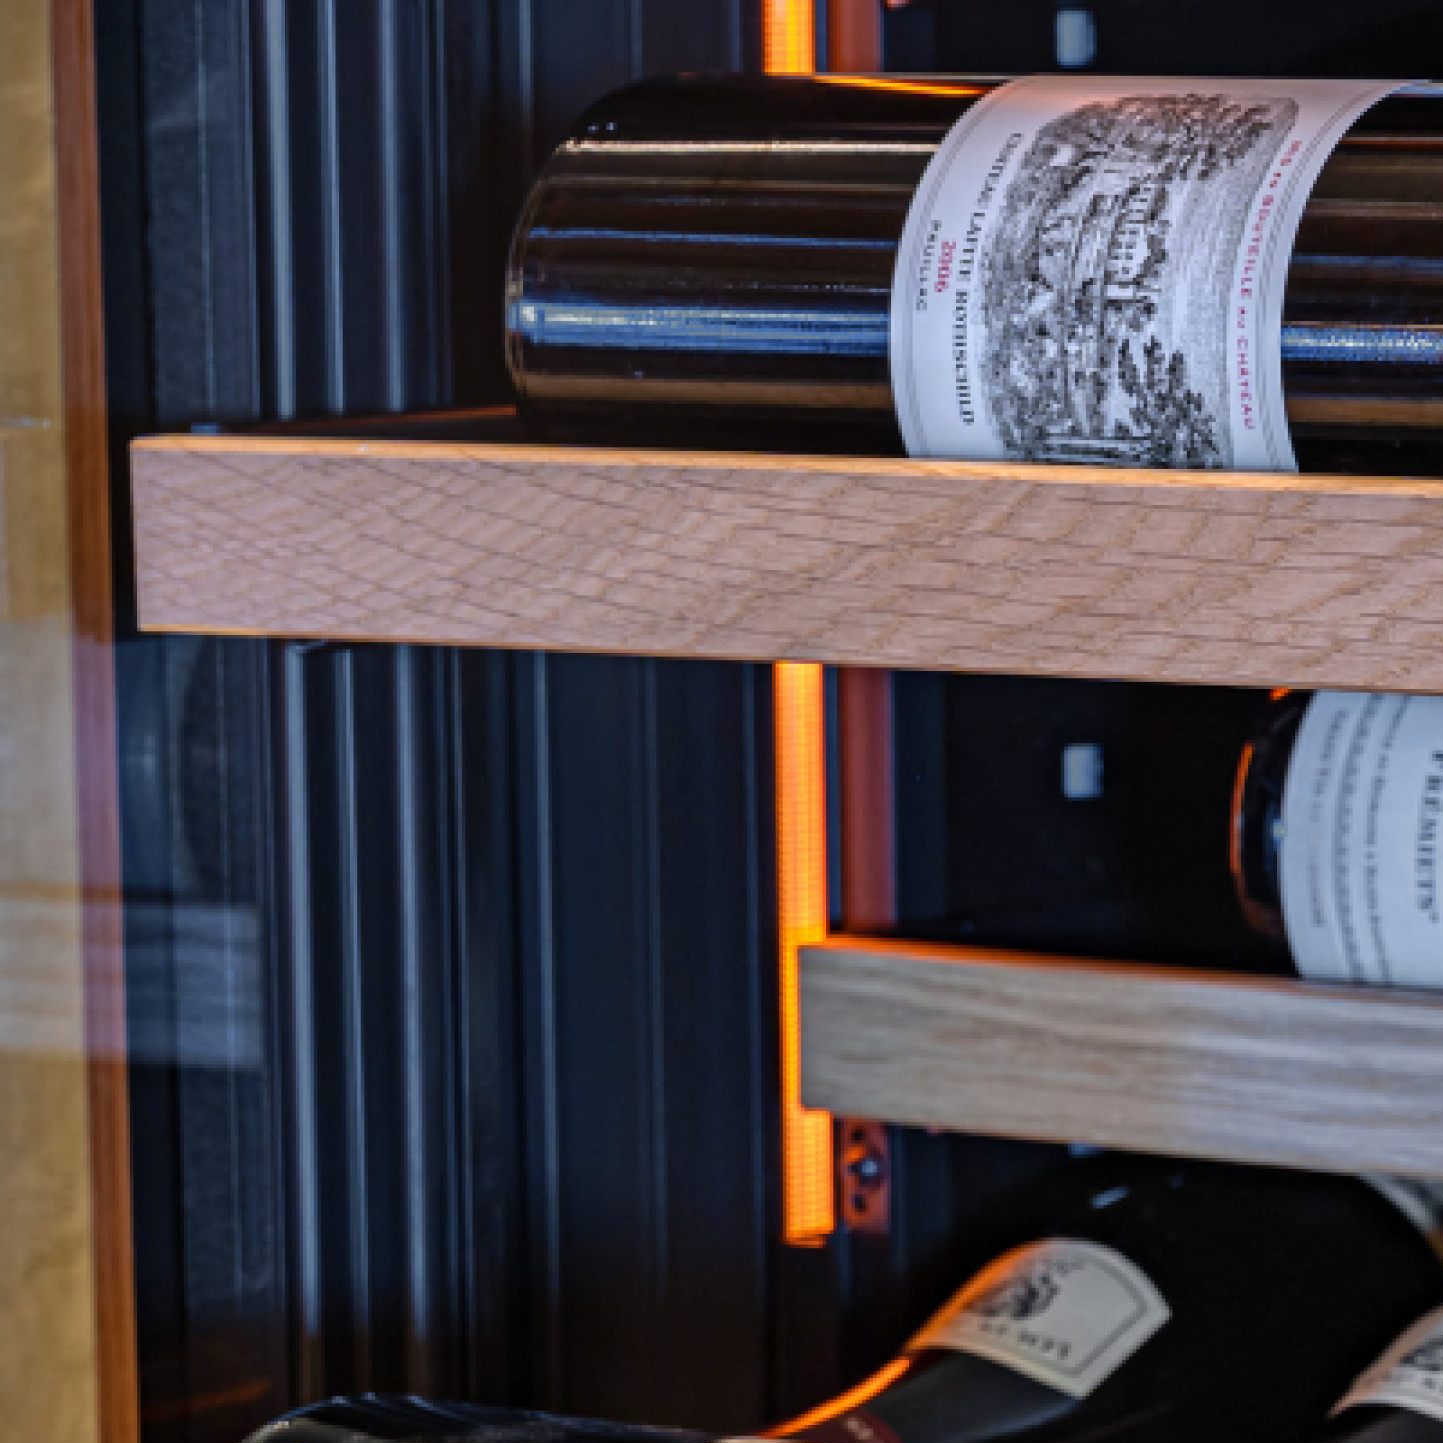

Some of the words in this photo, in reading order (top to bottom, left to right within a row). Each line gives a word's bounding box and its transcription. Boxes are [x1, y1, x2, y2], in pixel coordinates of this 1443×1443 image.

[915, 219, 942, 312] PAUILLAC
[933, 240, 957, 294] 2006
[958, 211, 987, 283] LAFITE
[1238, 194, 1276, 299] BOUTEILLE
[951, 290, 975, 427] ROTHSCHILD
